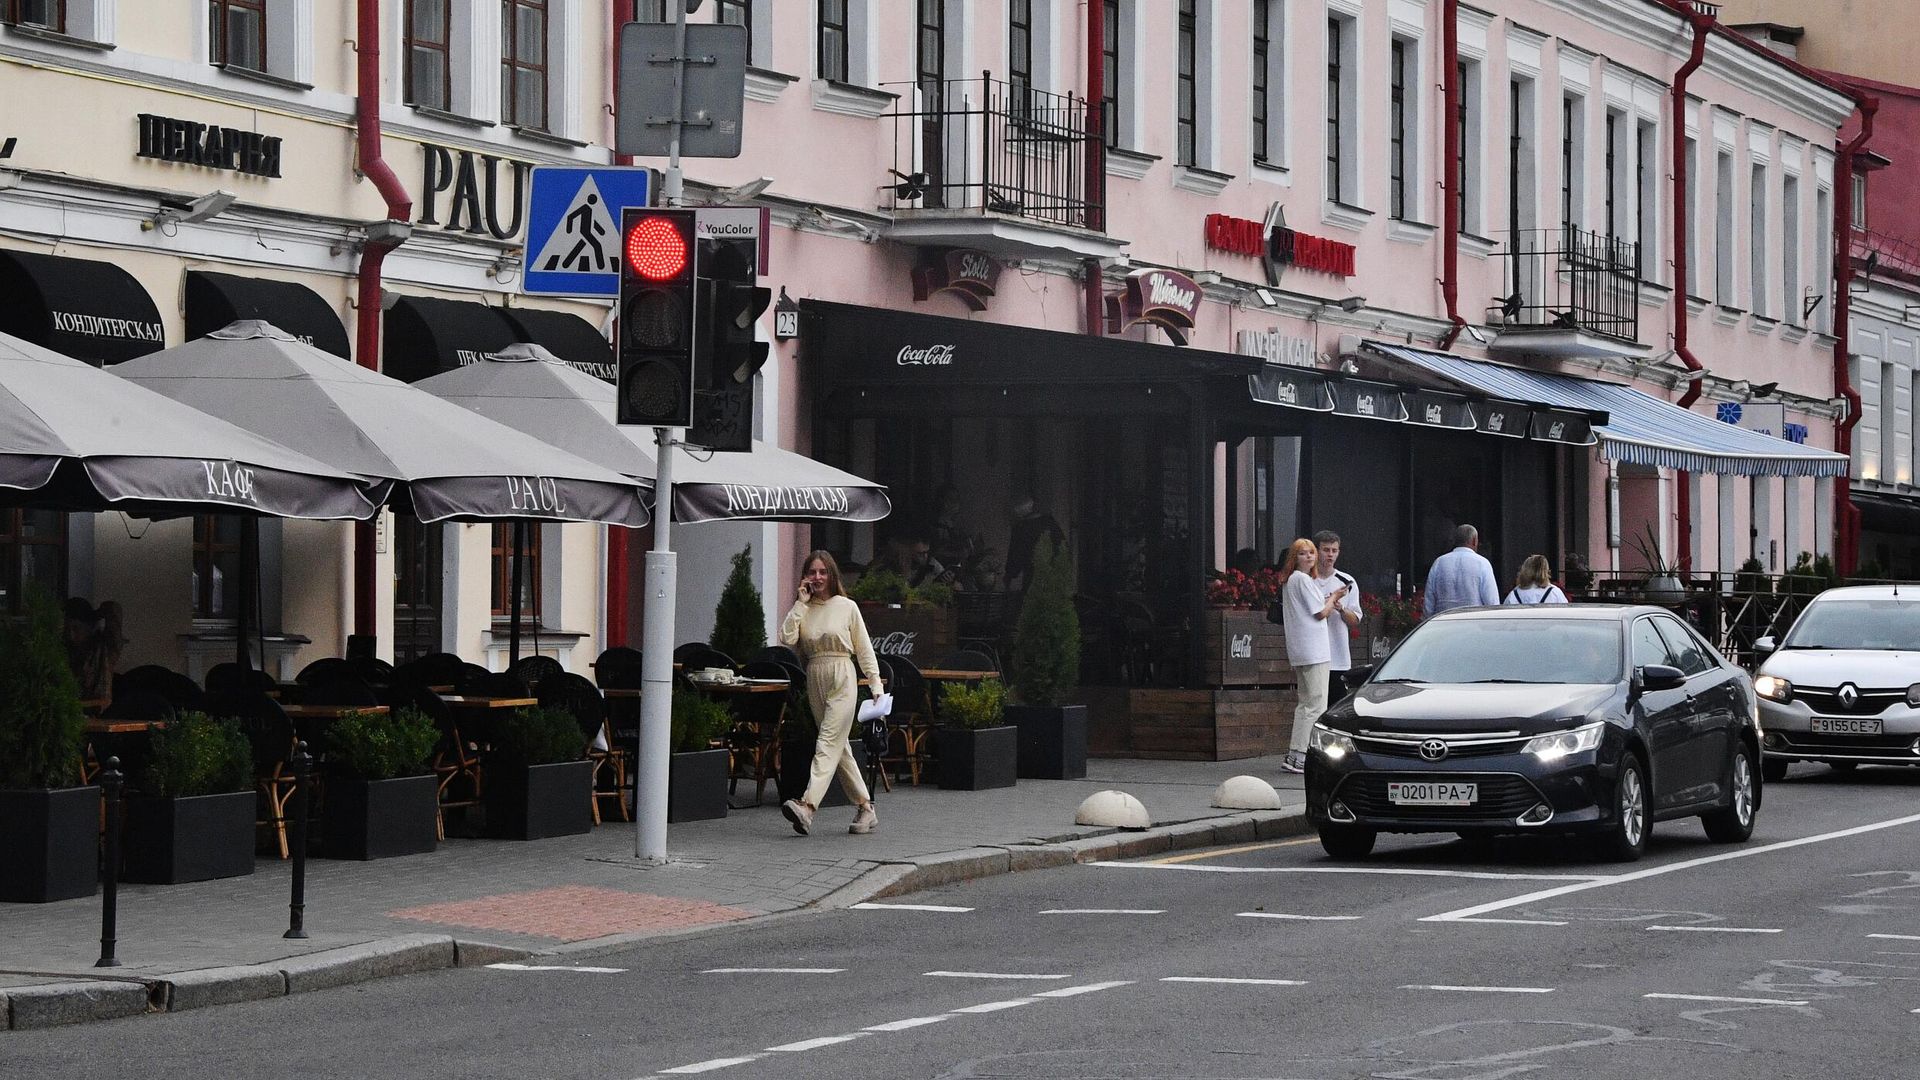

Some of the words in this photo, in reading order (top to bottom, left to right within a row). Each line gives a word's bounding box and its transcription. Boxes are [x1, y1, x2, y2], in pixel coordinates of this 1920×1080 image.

[136, 113, 283, 178] ПЕКАРНЯ
[417, 142, 535, 240] PAU
[705, 224, 753, 234] YouColor
[960, 254, 990, 280] Stolle
[52, 311, 163, 341] КОНДИТЕРСКАЯ
[779, 313, 796, 334] 23
[897, 344, 956, 366] Coca-Cola
[200, 460, 257, 503] КАФЕ
[505, 476, 567, 513] PAUL
[722, 484, 849, 516] КОНДИТЕРСКАЯ
[1822, 719, 1848, 732] 9155
[1850, 720, 1880, 733] CE-7
[1401, 784, 1433, 800] 0201
[1438, 784, 1475, 800] PA-7
